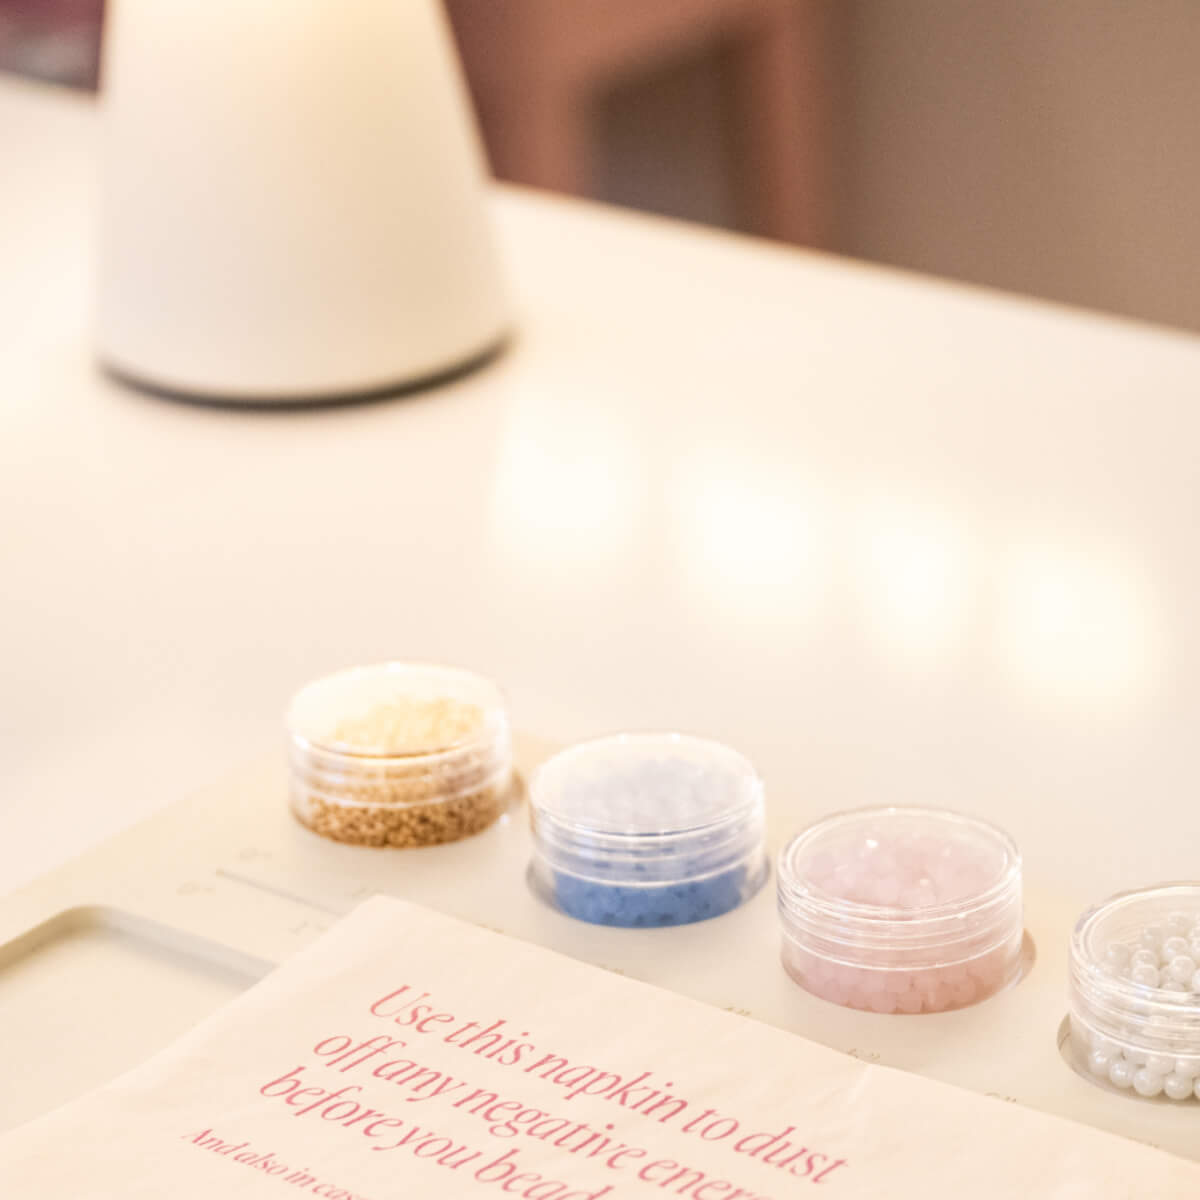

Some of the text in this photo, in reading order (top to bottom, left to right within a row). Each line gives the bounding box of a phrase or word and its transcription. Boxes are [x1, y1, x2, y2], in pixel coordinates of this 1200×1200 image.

[259, 1065, 404, 1137] before
[371, 1126, 483, 1170] you
[313, 1034, 407, 1073] off
[372, 1059, 468, 1102] any
[451, 1089, 648, 1169] negative
[370, 984, 848, 1183] Use this napkin to dust
[180, 1128, 251, 1156] And
[232, 1152, 290, 1176] also
[283, 1167, 318, 1188] in
